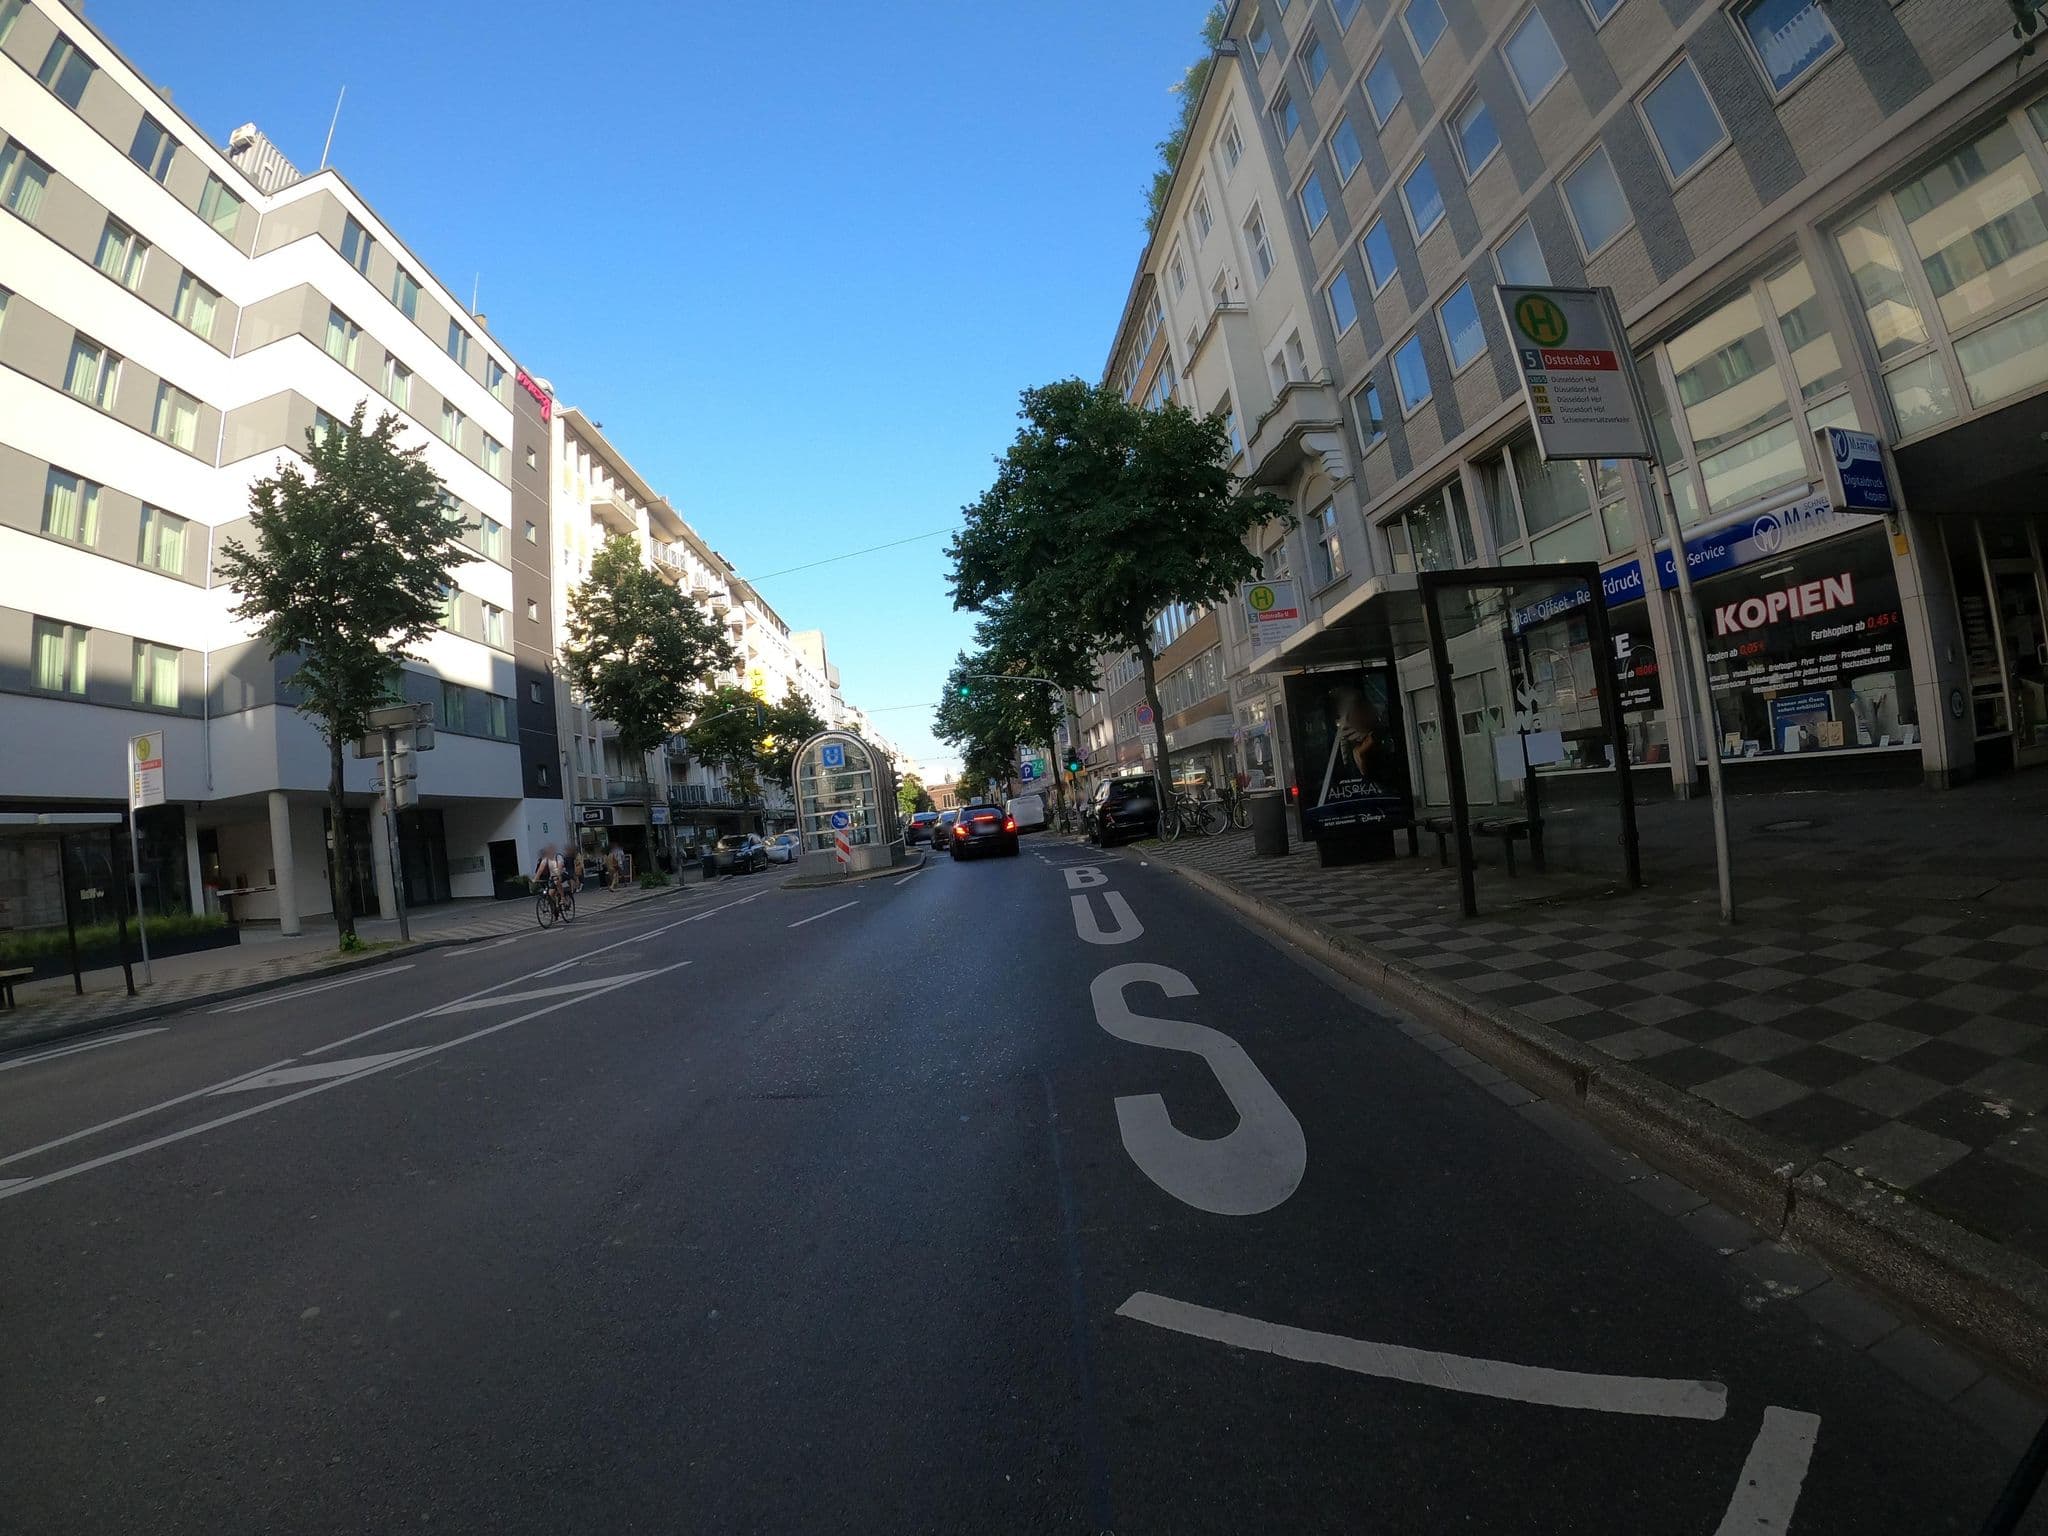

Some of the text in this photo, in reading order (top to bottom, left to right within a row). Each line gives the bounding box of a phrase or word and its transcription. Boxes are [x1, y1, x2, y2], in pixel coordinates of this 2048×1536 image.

[1526, 303, 1558, 336] H
[1525, 351, 1537, 368] 5
[1544, 354, 1601, 366] Oststraße U
[1255, 590, 1269, 606] H
[1537, 596, 1570, 618] Offset
[1714, 572, 1856, 637] KOPIEN
[1811, 622, 1854, 641] Farbkopien
[1854, 620, 1866, 632] ab
